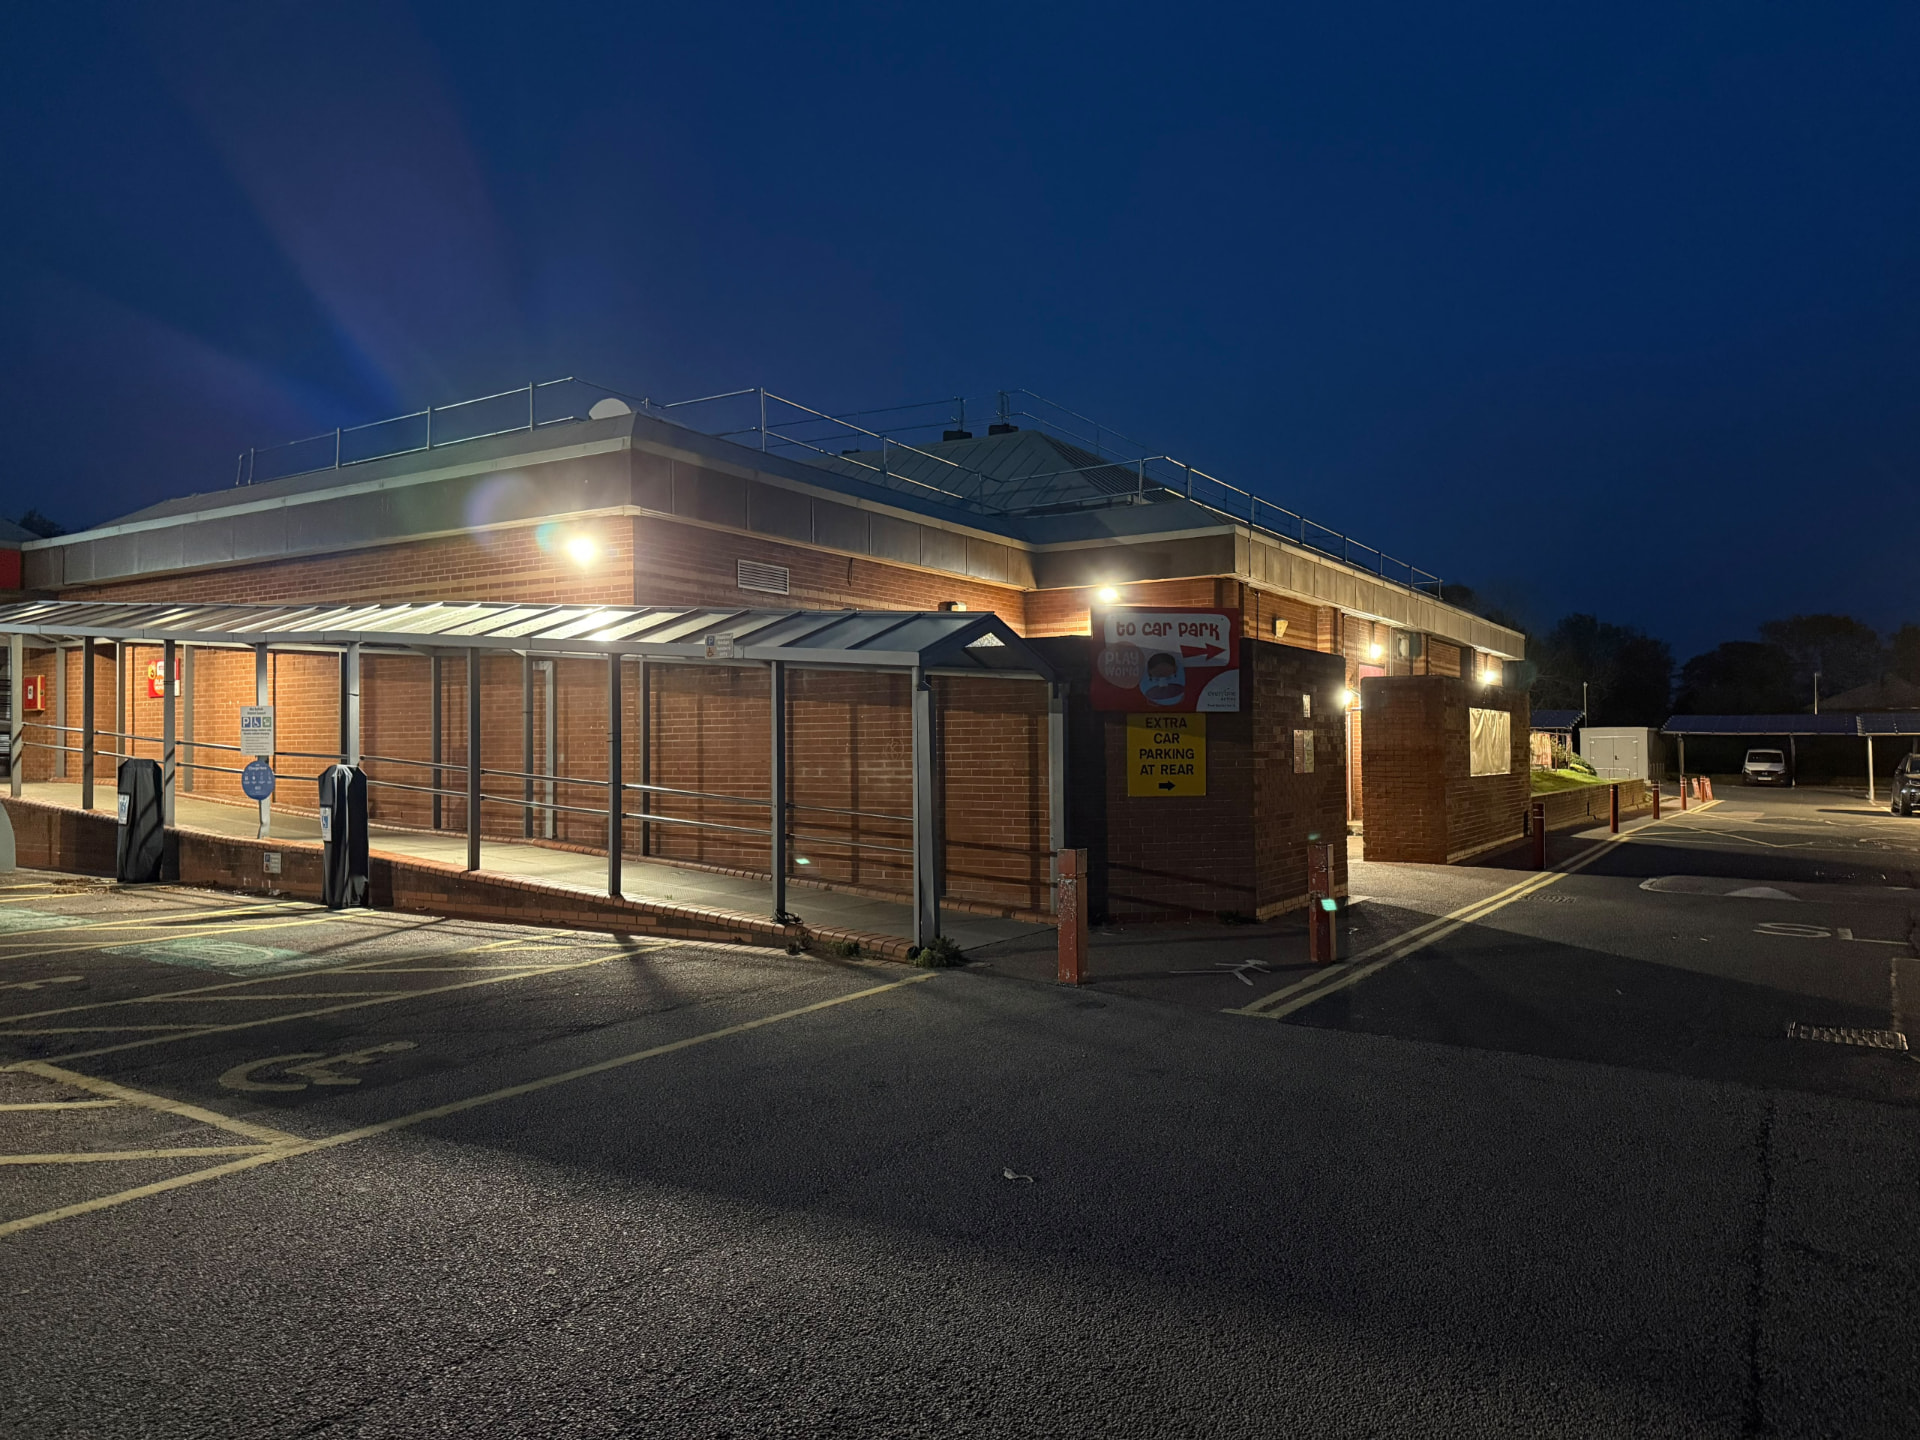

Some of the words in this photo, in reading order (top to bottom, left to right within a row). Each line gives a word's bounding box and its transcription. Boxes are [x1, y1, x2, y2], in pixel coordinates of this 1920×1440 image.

[1116, 622, 1136, 636] to
[1142, 622, 1172, 637] car
[1178, 622, 1219, 641] park
[1105, 651, 1139, 665] PLAY
[1145, 717, 1187, 728] EXTRA
[1153, 733, 1180, 744] CAR
[1139, 748, 1194, 759] PARKING
[1140, 764, 1155, 775] AT
[1160, 764, 1194, 775] REAR
